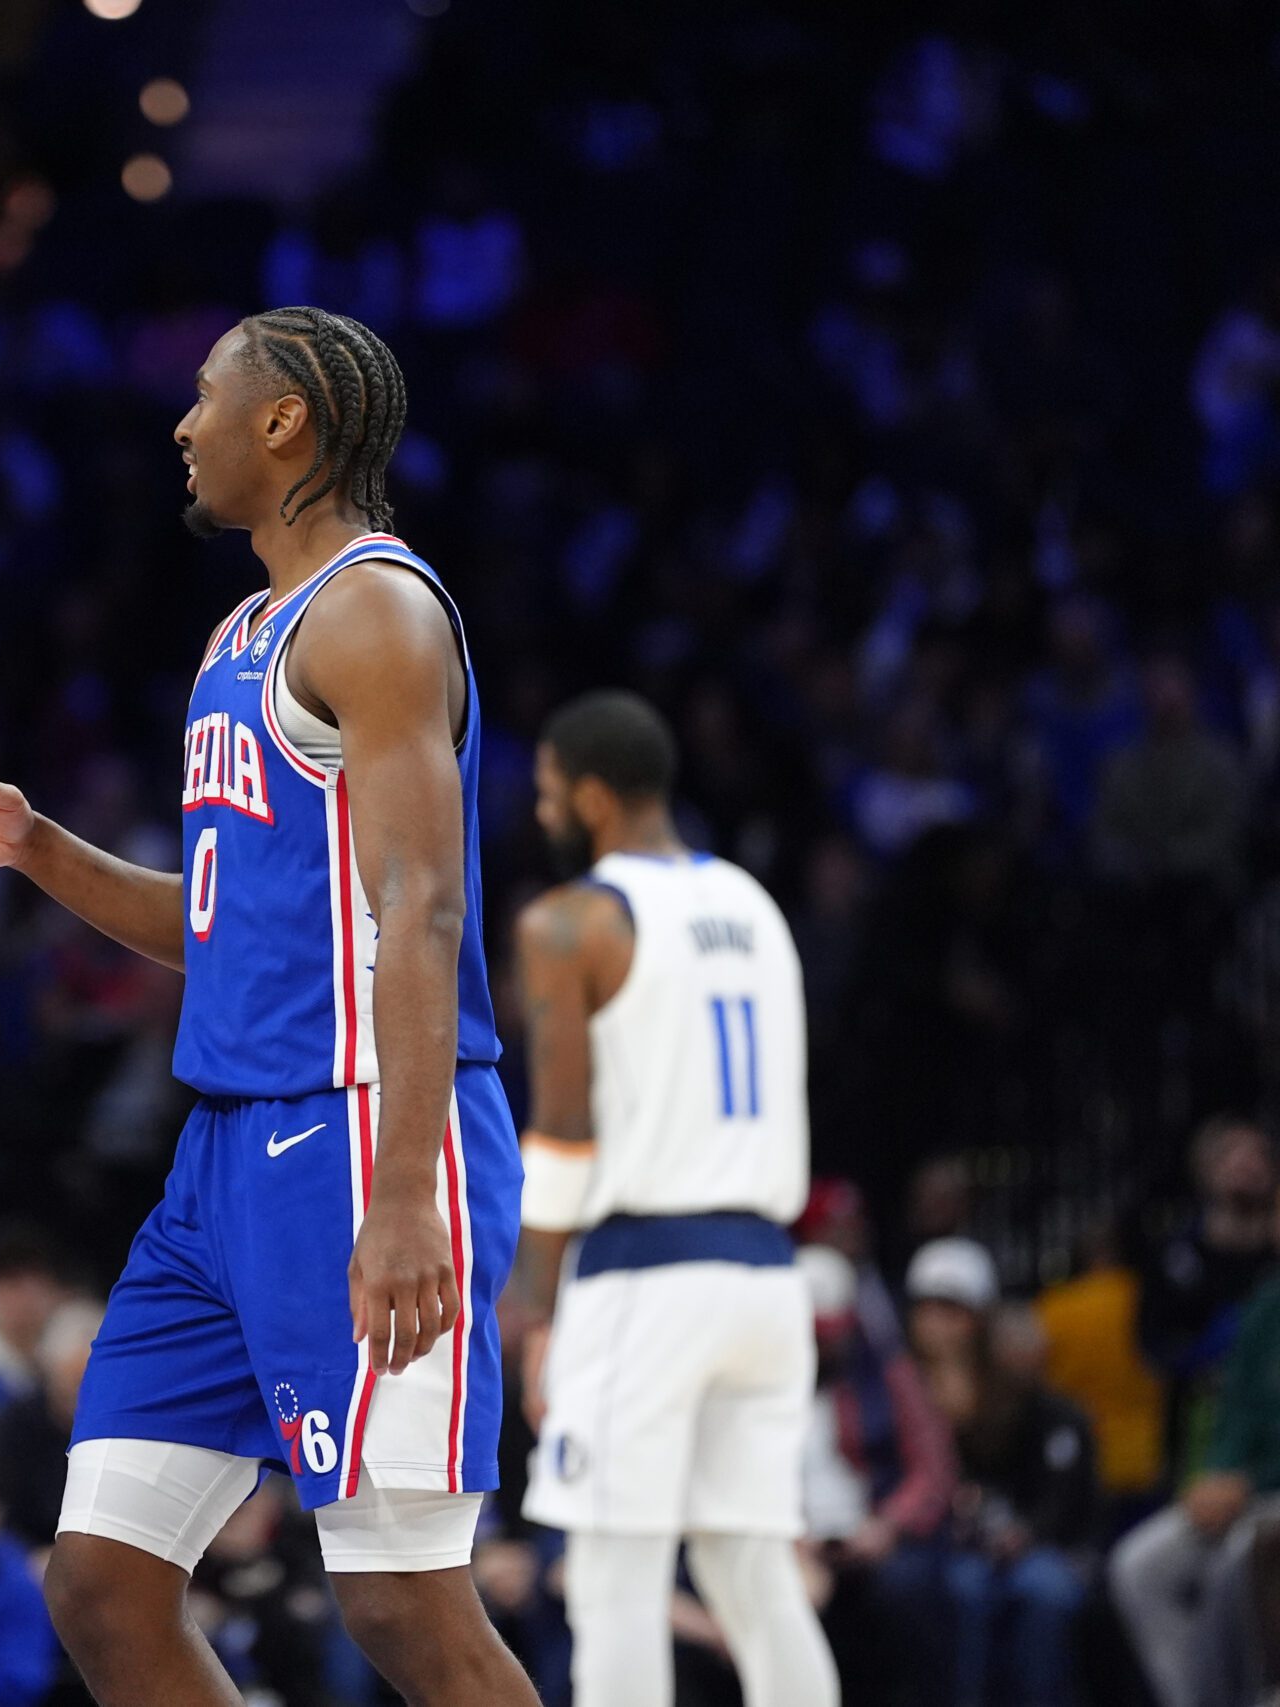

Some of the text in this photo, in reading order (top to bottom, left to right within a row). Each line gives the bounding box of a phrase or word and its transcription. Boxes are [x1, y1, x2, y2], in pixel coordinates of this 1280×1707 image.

[182, 712, 274, 826] HILA
[190, 828, 218, 942] 0
[710, 996, 759, 1117] 11
[279, 1410, 338, 1475] 76
